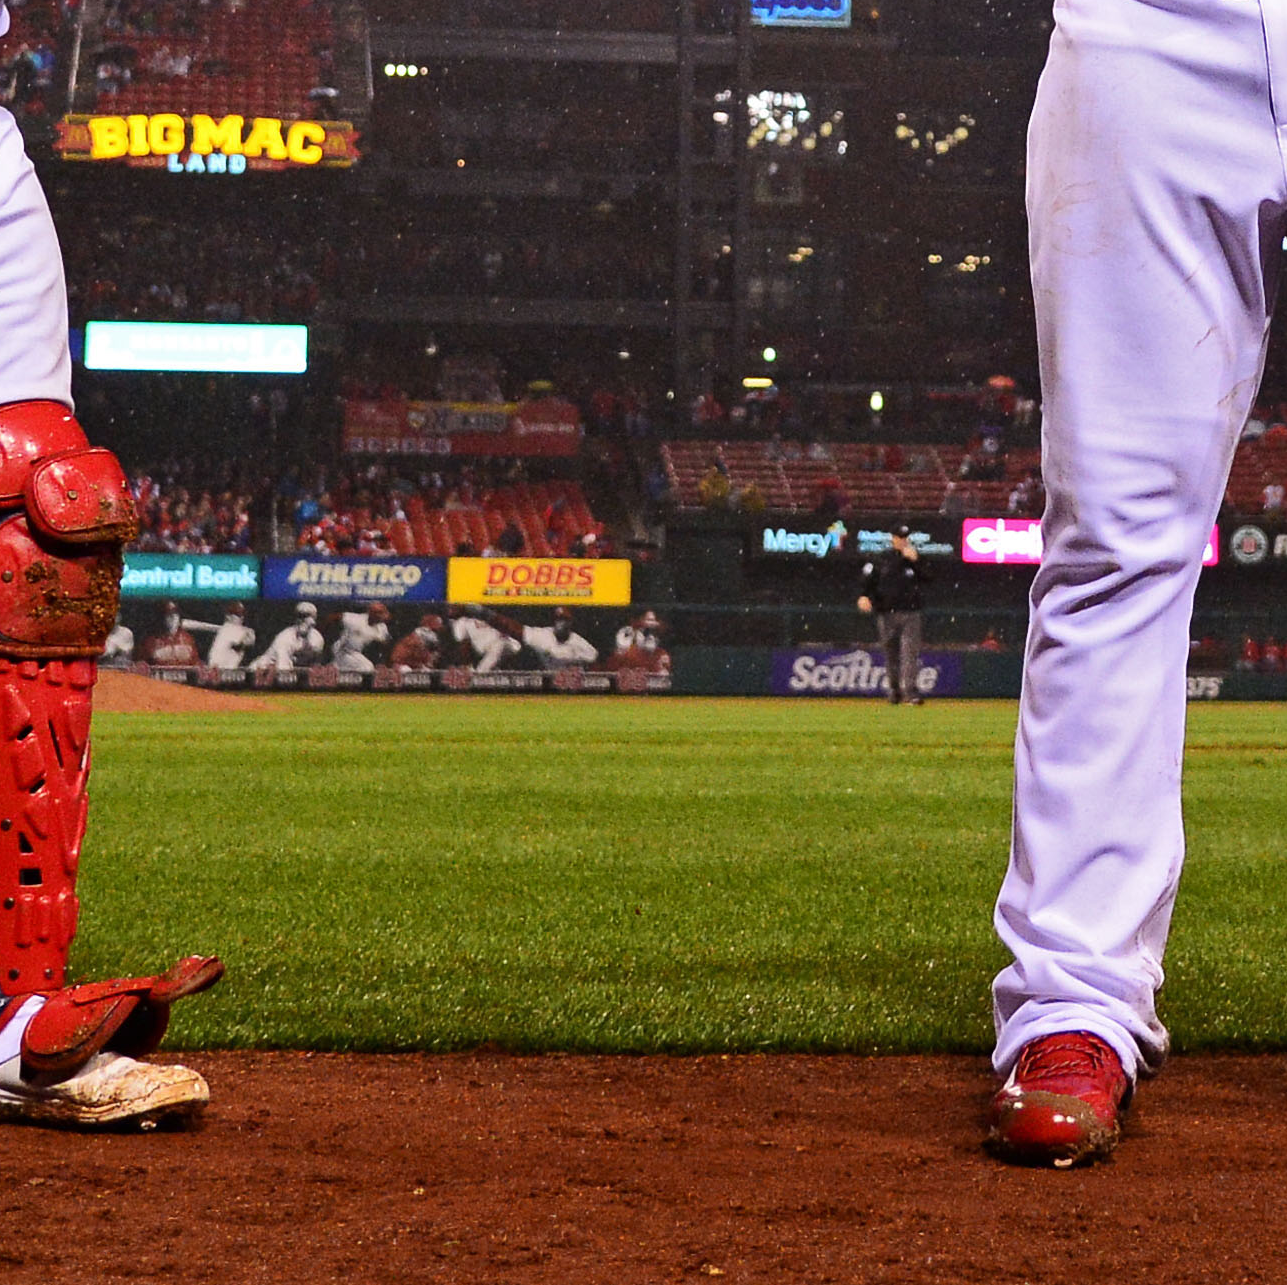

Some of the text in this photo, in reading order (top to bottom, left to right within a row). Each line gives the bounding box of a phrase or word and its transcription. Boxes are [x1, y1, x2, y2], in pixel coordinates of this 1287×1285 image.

[89, 114, 325, 164] BIG MAC
[167, 153, 247, 174] LAND
[763, 528, 831, 558] Mercy
[195, 563, 258, 588] Bank
[288, 560, 423, 588] ATHLETICO
[487, 563, 595, 586] DOBBS
[789, 650, 938, 692] Scottre
